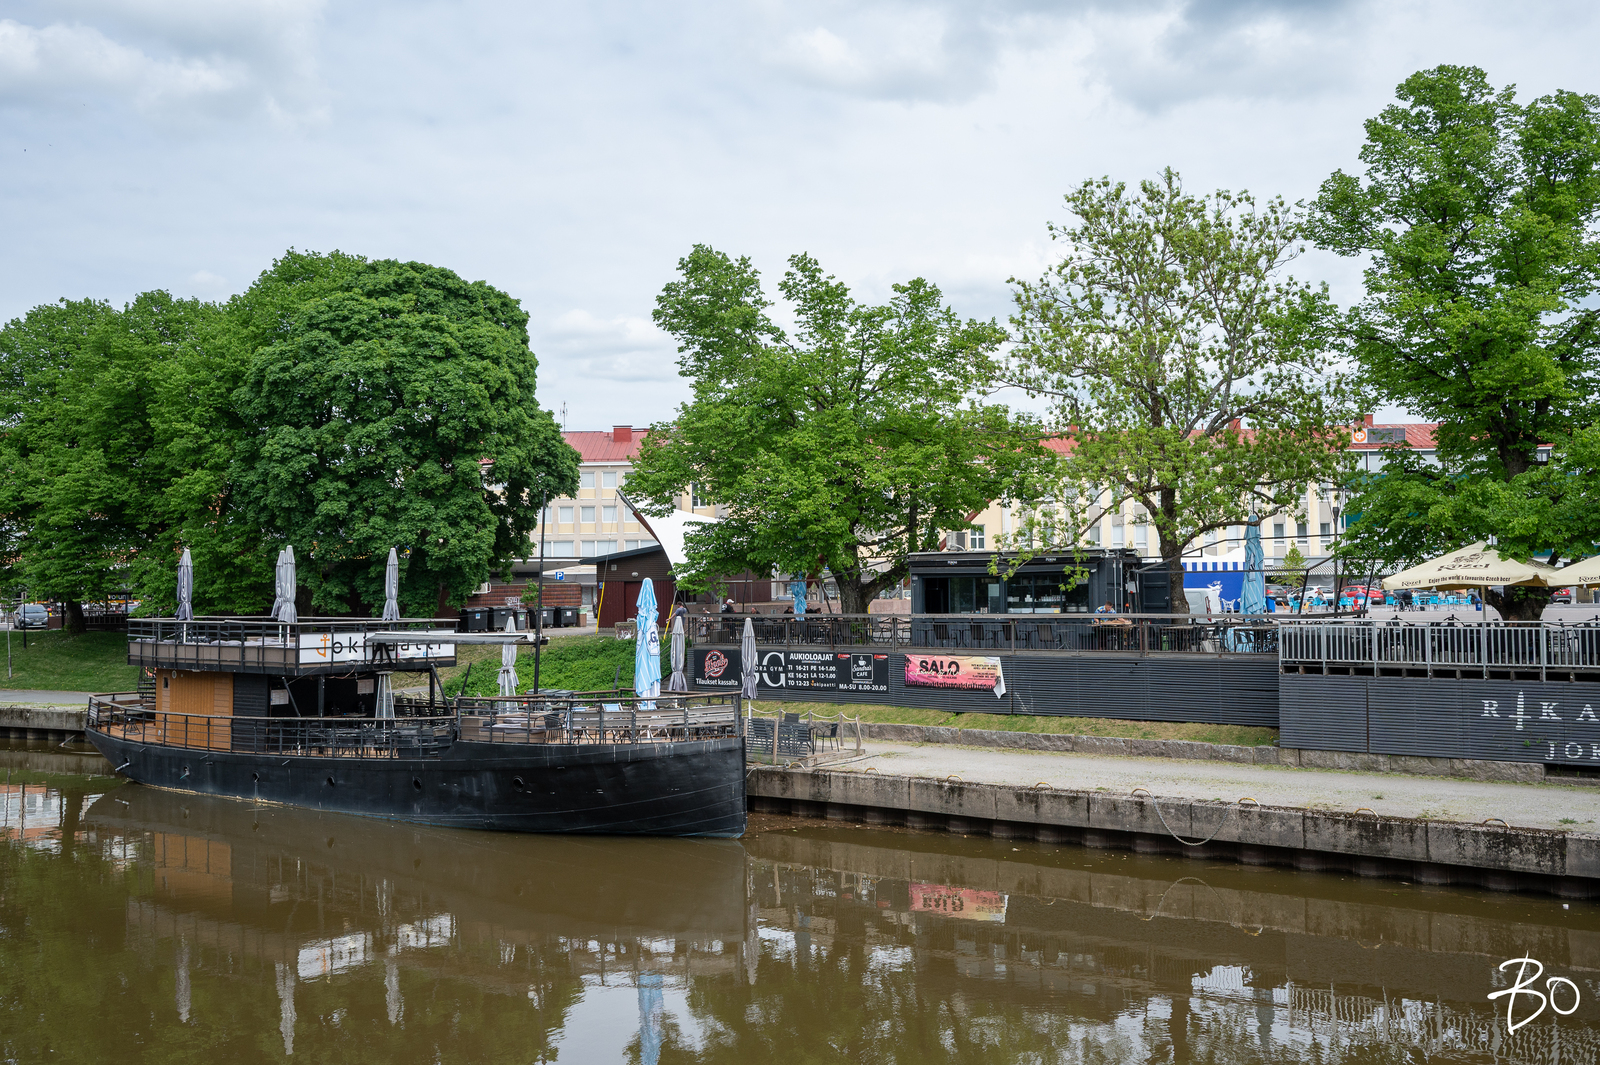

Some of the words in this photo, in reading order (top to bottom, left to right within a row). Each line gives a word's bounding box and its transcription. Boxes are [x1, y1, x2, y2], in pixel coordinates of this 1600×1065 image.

[790, 652, 834, 661] AUKIOLOAJAT
[919, 660, 960, 675] SALO
[718, 678, 738, 686] kassalta
